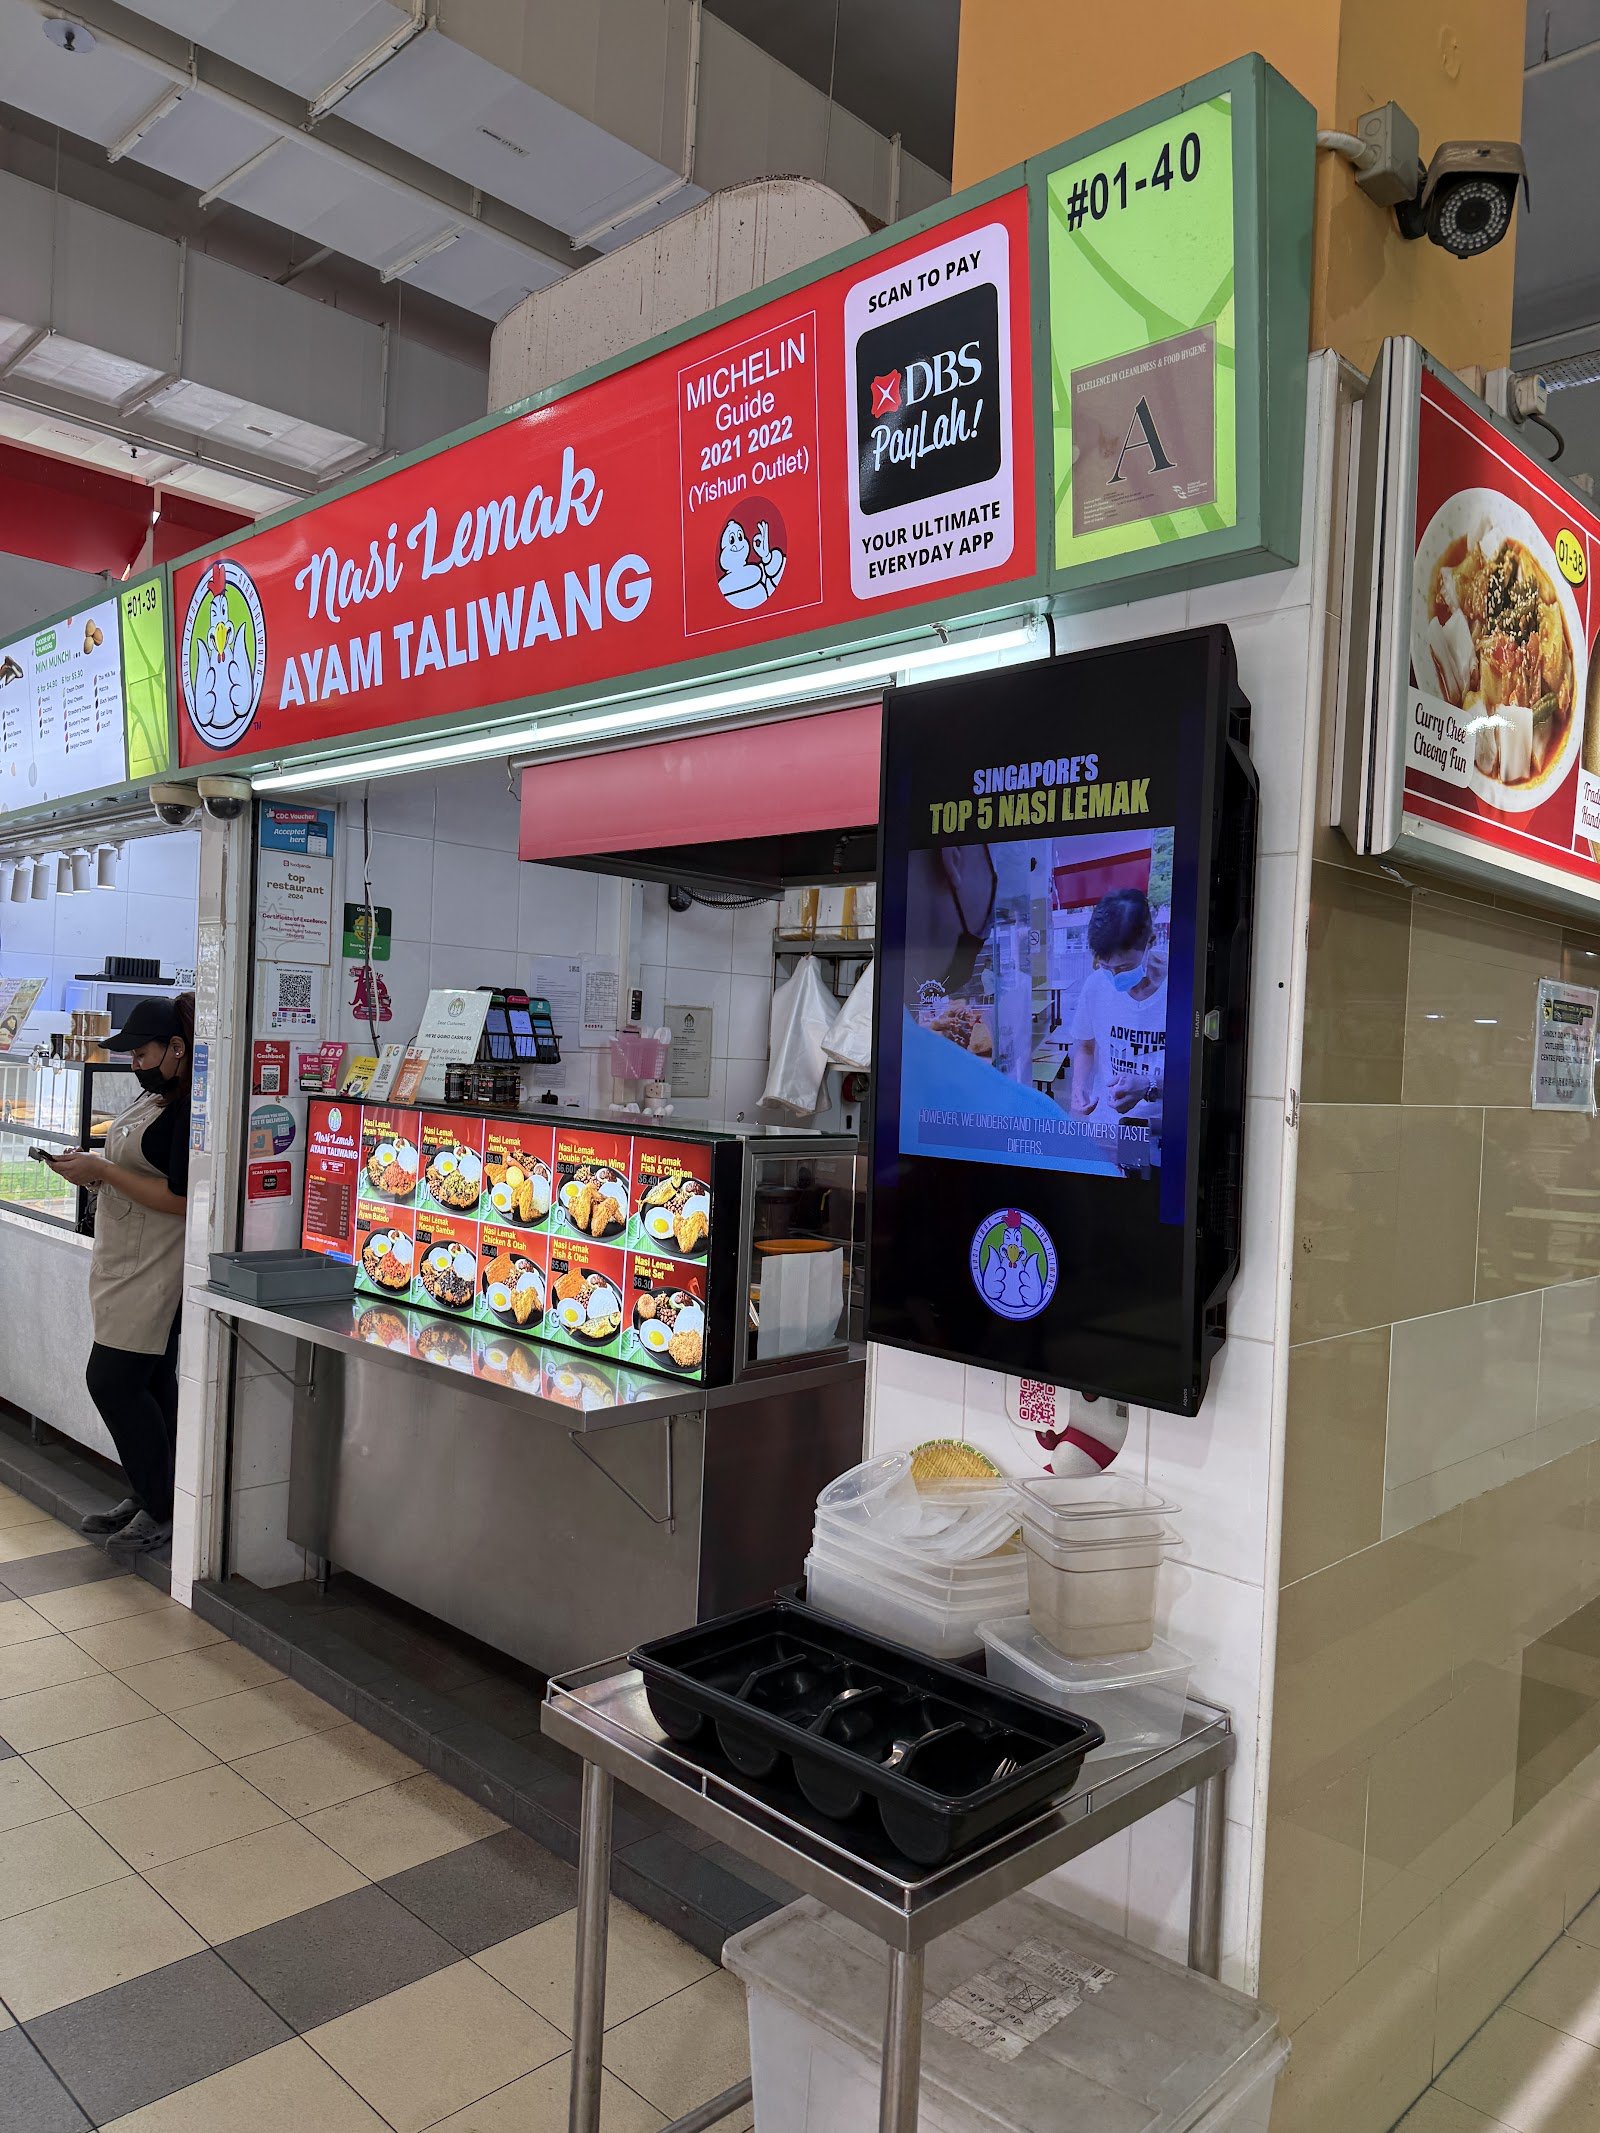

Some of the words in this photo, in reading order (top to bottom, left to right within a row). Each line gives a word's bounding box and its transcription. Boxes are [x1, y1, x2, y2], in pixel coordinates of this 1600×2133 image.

[1067, 132, 1201, 232] #01-40
[867, 280, 913, 314] SCAN
[917, 268, 940, 293] TO
[945, 250, 982, 281] PAY
[686, 332, 805, 412] MICHELIN
[904, 340, 982, 407] DBS
[1076, 374, 1111, 393] EXCELLENCE
[1111, 372, 1118, 385] IN
[1118, 360, 1157, 381] CLEANLINESS
[1158, 359, 1163, 368] &
[1163, 352, 1180, 367] FOOD
[1181, 343, 1207, 361] HYGIENE
[715, 390, 775, 432] Guide
[870, 397, 984, 472] PayLah!
[1106, 395, 1178, 485] A
[700, 435, 741, 472] 2021
[748, 415, 793, 454] 2022
[688, 473, 747, 513] (Yishun
[752, 445, 809, 486] Outlet)
[295, 522, 403, 623] Nasi
[406, 446, 604, 581] Lemak
[861, 528, 907, 555] YOUR
[912, 500, 1001, 541] ULTIMATE
[868, 541, 954, 579] EVERYDAY
[959, 531, 994, 557] APP
[1559, 540, 1583, 575] 01-38
[127, 586, 157, 619] #01-39
[278, 630, 383, 711] AYAM
[393, 553, 652, 680] TALIWANG
[1415, 703, 1444, 741] Curry
[1446, 716, 1466, 744] Chee
[1414, 732, 1447, 772] Cheong
[1450, 747, 1467, 773] Fun
[972, 753, 1099, 795] SINGAPORE'S
[930, 799, 973, 835] TOP
[977, 797, 993, 830] 5
[998, 789, 1057, 828] NASI
[1062, 777, 1151, 821] LEMAK
[273, 828, 306, 836] Accepted
[288, 872, 305, 884] top
[266, 881, 325, 894] restaurant
[363, 1119, 374, 1128] Nasi
[375, 1120, 390, 1128] Lemak
[424, 1126, 436, 1135] Nasi
[436, 1128, 453, 1136] Lemak
[919, 1109, 959, 1127] HOWEVER,
[961, 1112, 974, 1127] WE
[976, 1114, 1031, 1132] UNDERSTAND
[1033, 1118, 1056, 1134] THAT
[1058, 1120, 1116, 1139] CUSTOMER'S
[1118, 1124, 1150, 1143] TASTE
[313, 1131, 330, 1143] Nasi
[330, 1134, 354, 1146] Lemak
[363, 1128, 377, 1137] Ayam
[424, 1135, 438, 1144] Ayam
[439, 1137, 452, 1146] Cabe
[488, 1134, 500, 1143] Nasi
[502, 1136, 520, 1146] Lemak
[310, 1144, 326, 1155] AYAM
[327, 1146, 358, 1159] TALIWANG
[487, 1143, 507, 1153] Jumbo
[558, 1143, 573, 1153] Nasi
[574, 1145, 594, 1155] Lemak
[1007, 1138, 1043, 1155] DIFFERS.
[486, 1155, 502, 1164] $8.90
[558, 1152, 580, 1163] Double
[581, 1155, 607, 1167] Chicken
[608, 1158, 625, 1171] Wing
[641, 1153, 656, 1164] Nasi
[658, 1155, 681, 1167] Lemak
[556, 1164, 574, 1174] $6.60
[641, 1163, 655, 1174] Fish
[657, 1166, 662, 1174] &
[664, 1166, 692, 1179] Chicken
[638, 1174, 657, 1185] $6.40
[359, 1202, 370, 1210] Nasi
[371, 1204, 386, 1212] Lemak
[359, 1210, 372, 1219] Ayam
[419, 1213, 430, 1222] Nasi
[431, 1216, 448, 1226] Lemak
[418, 1222, 435, 1232] Kecap
[436, 1225, 455, 1236] Sambal
[483, 1226, 496, 1236] Nasi
[497, 1228, 516, 1239] Lemak
[483, 1235, 505, 1246] Chicken
[506, 1238, 511, 1247] &
[513, 1240, 526, 1251] Otah
[553, 1239, 567, 1249] Nasi
[568, 1243, 589, 1254] Lemak
[552, 1248, 567, 1259] Fish
[567, 1252, 573, 1260] &
[574, 1253, 588, 1264] Otah
[635, 1255, 649, 1267] Nasi
[652, 1259, 674, 1272] Lemak
[552, 1260, 568, 1272] $5.90
[634, 1265, 651, 1277] Fillet
[652, 1269, 664, 1280] Set
[633, 1277, 651, 1290] $6.30
